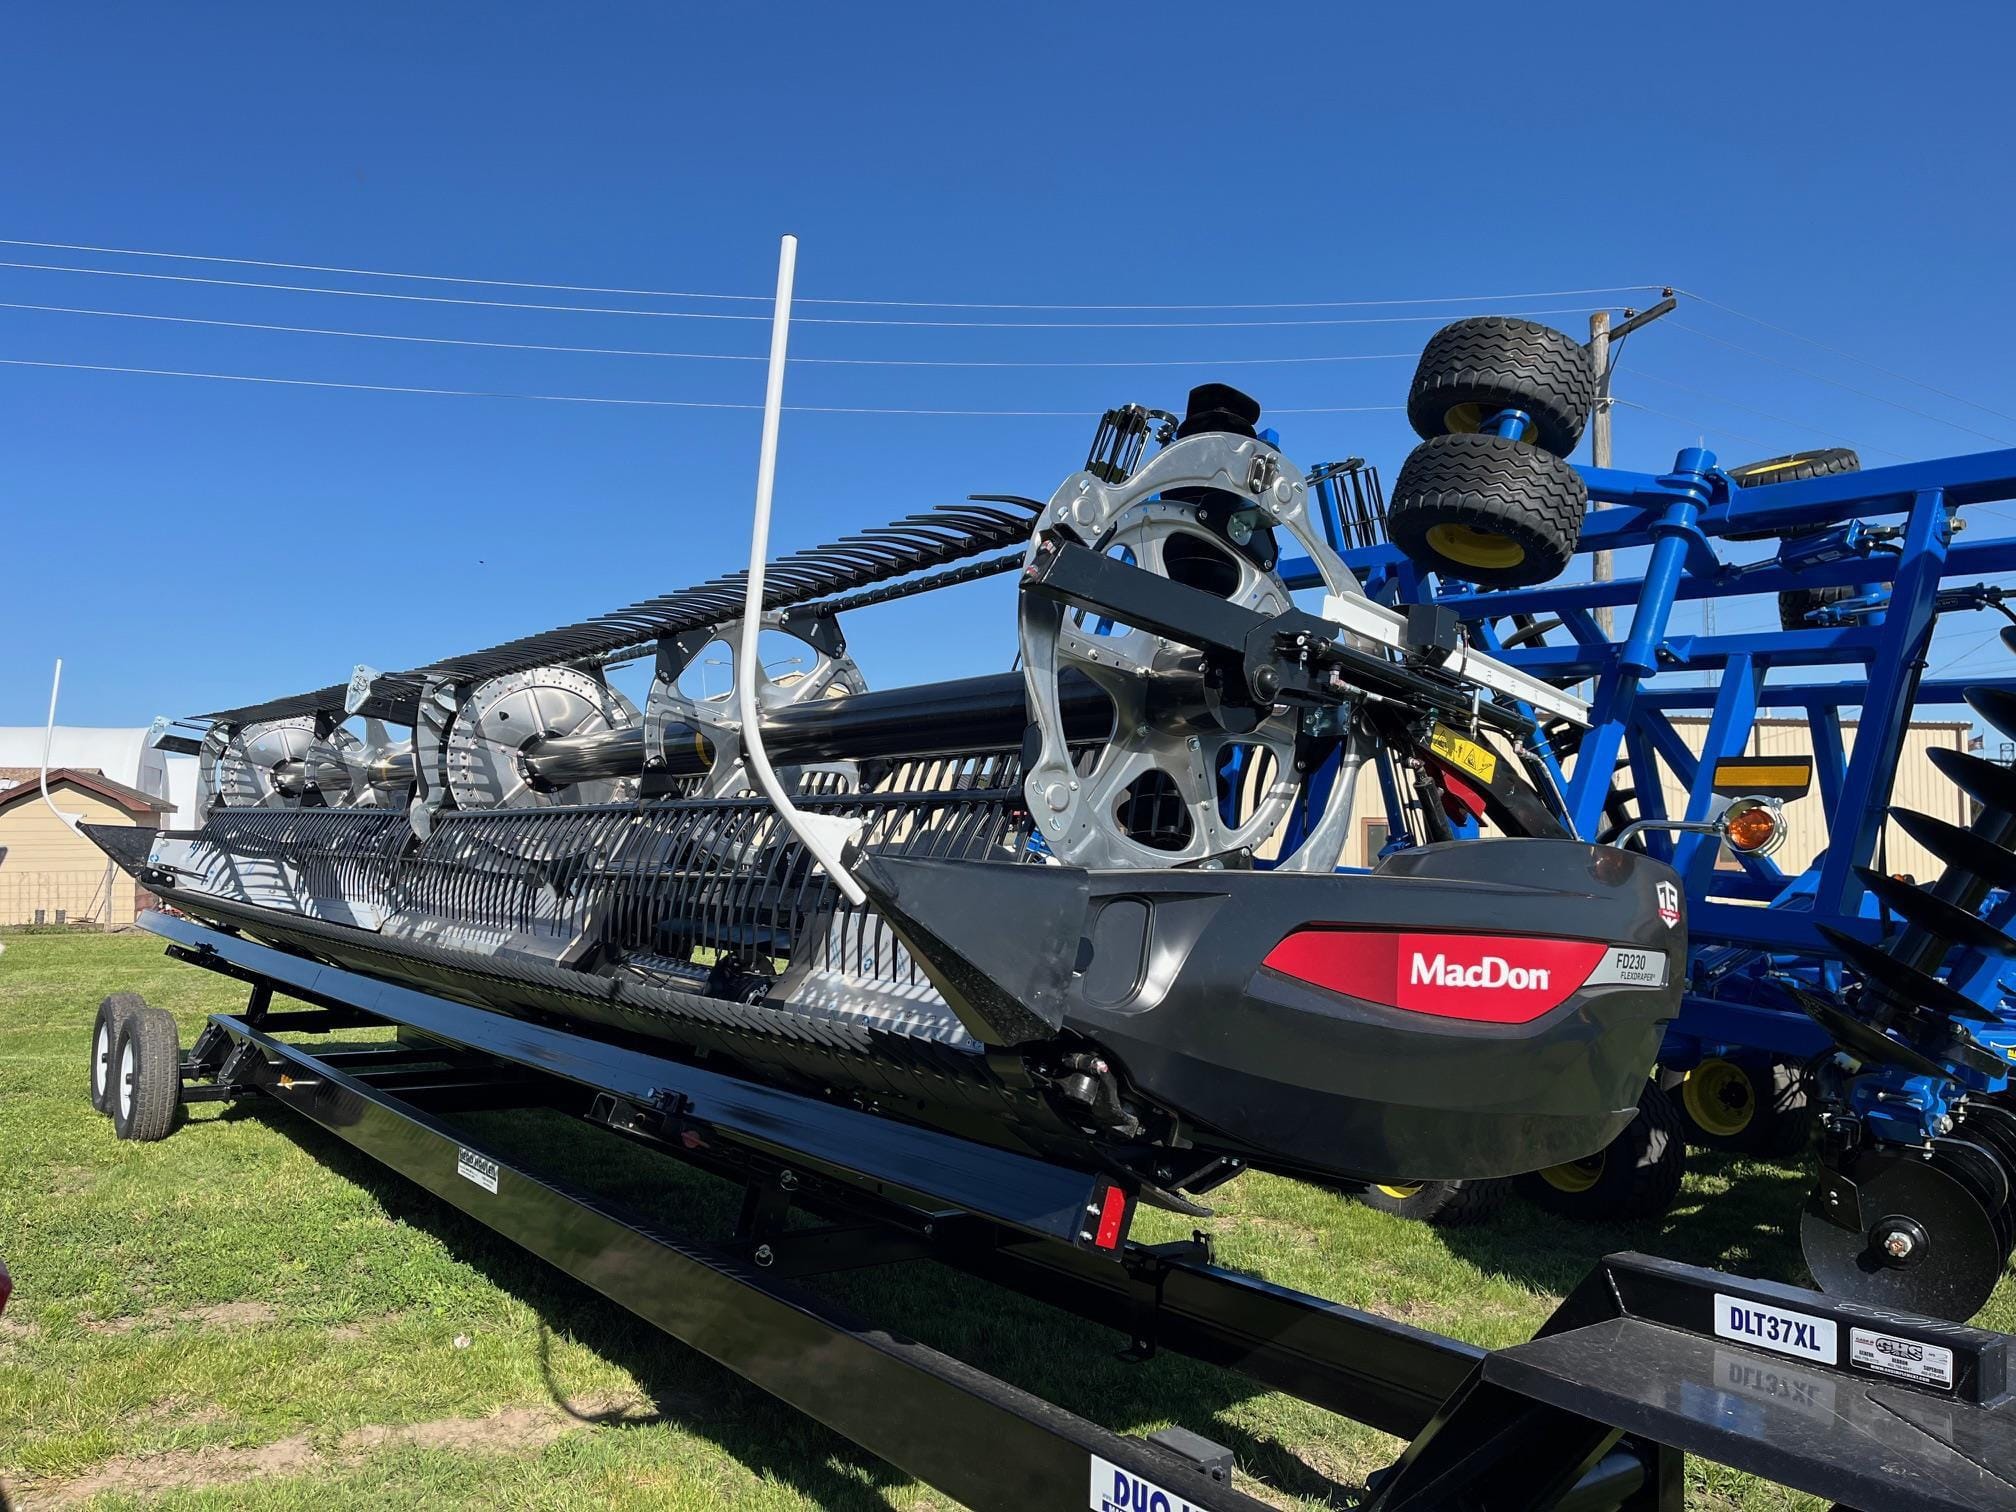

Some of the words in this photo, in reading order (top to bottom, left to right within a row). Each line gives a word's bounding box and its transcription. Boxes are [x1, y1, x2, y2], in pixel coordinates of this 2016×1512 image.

[1410, 952, 1549, 990] MacDon
[1616, 953, 1647, 970] FD230
[1730, 1306, 1821, 1351] DLT37XL
[1114, 1470, 1171, 1512] DUO
